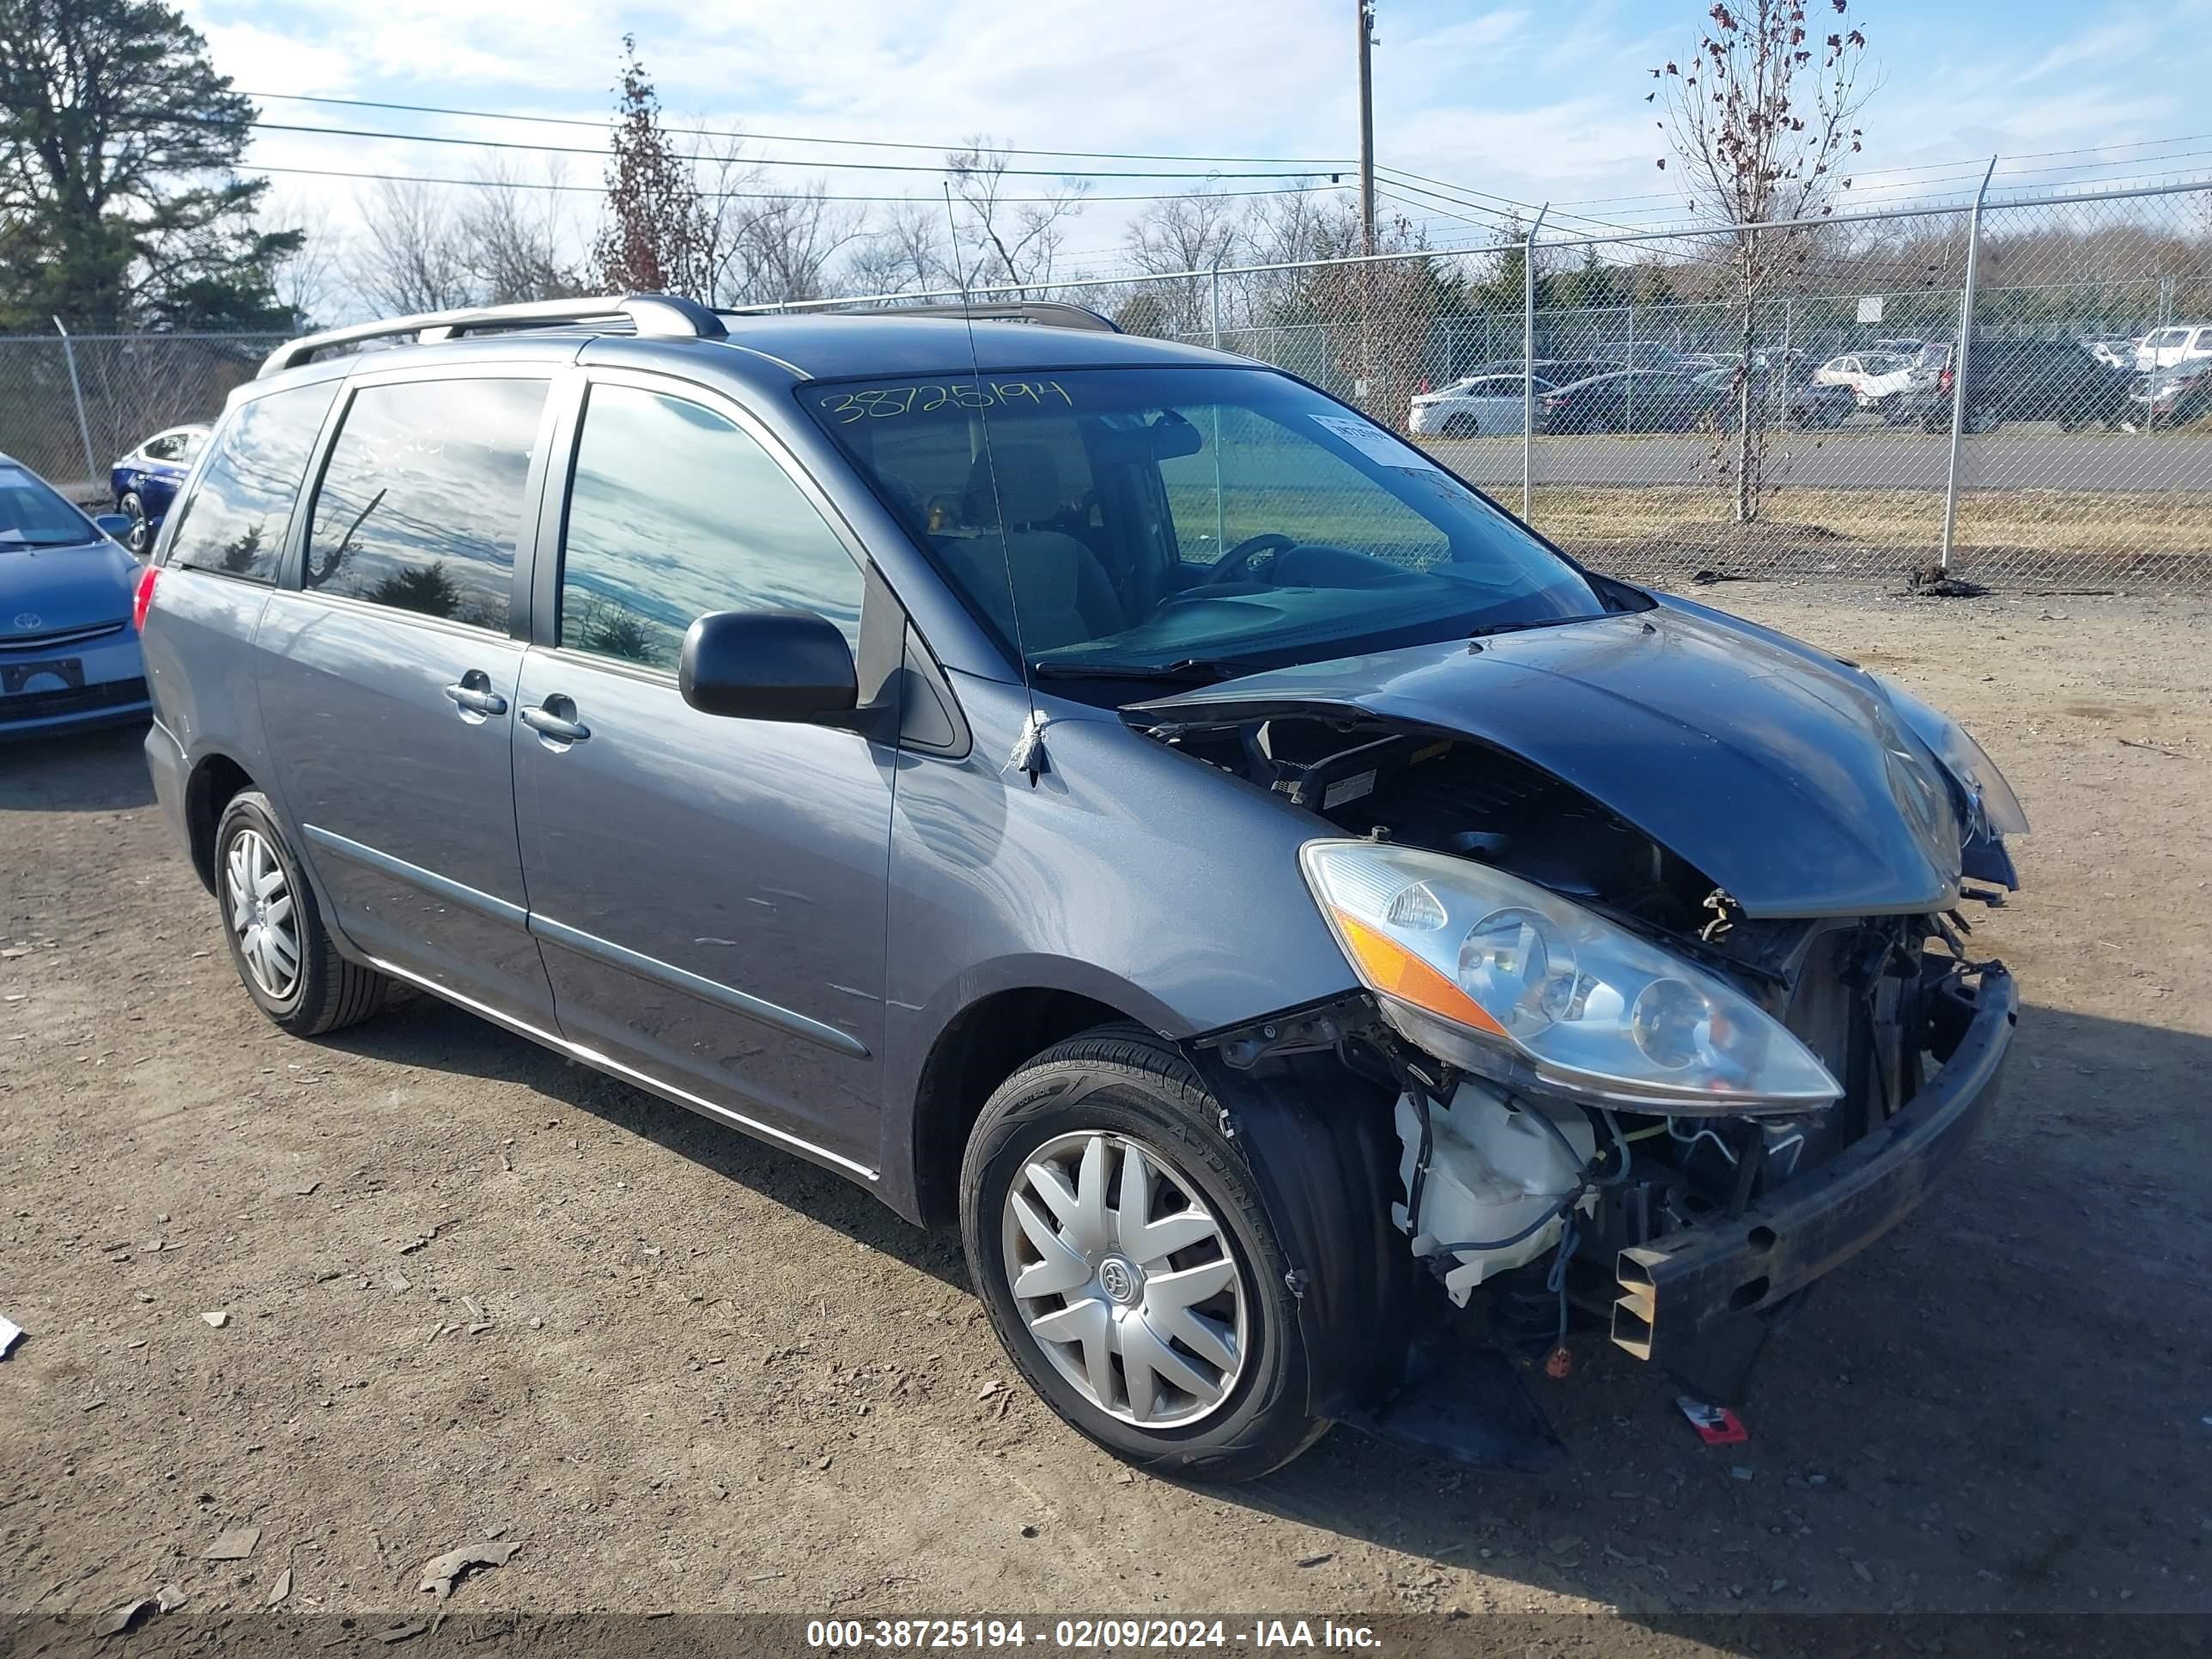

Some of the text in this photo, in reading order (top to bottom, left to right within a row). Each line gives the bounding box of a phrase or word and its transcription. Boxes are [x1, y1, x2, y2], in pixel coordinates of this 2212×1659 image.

[820, 380, 1073, 423] 38725194
[1017, 1086, 1051, 1106] OUTSIDE
[1168, 1122, 1255, 1210] ASPEN
